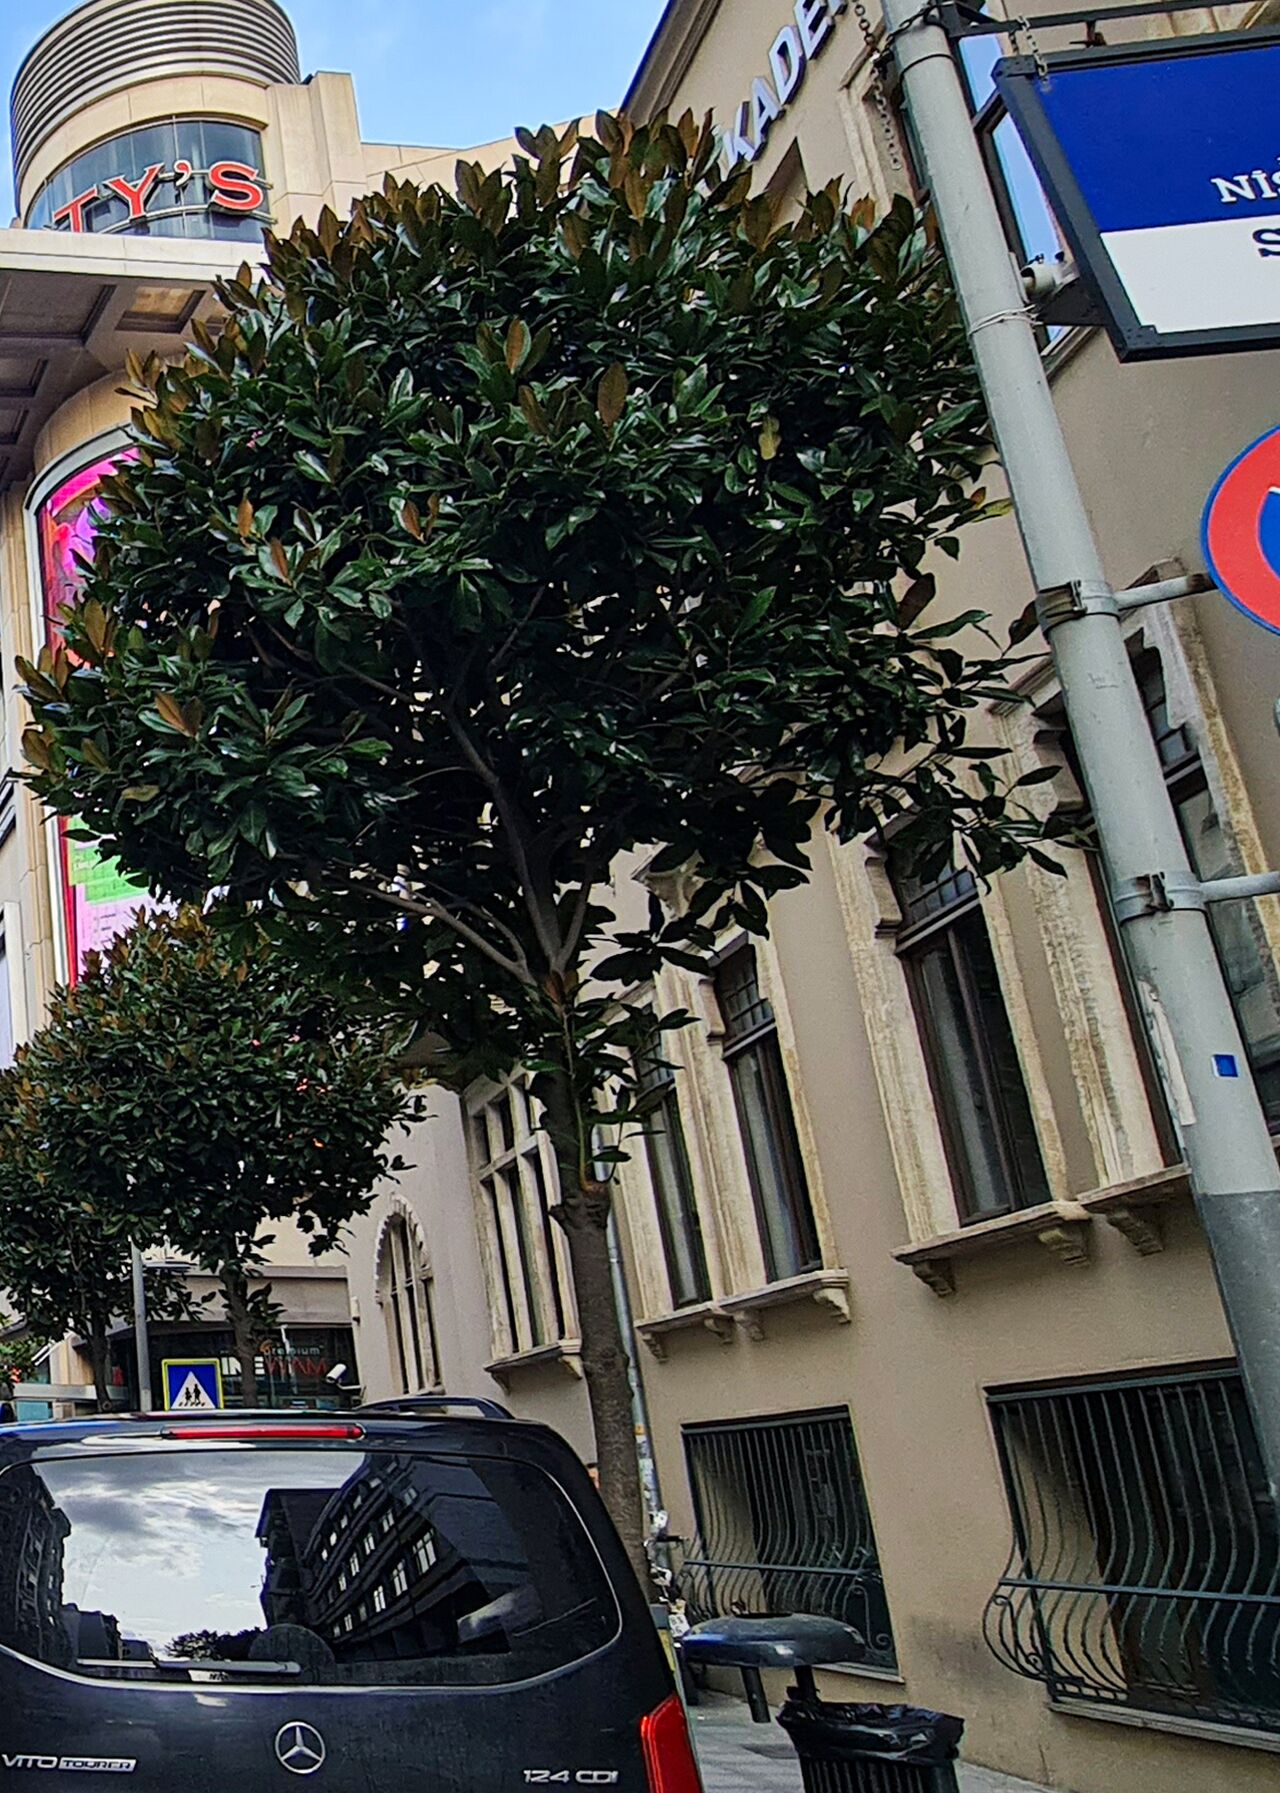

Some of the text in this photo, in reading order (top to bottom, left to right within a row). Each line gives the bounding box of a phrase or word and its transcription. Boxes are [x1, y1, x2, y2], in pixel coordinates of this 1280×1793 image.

[717, 0, 847, 182] KADE
[1, 1753, 133, 1771] VITO TOURER
[523, 1769, 619, 1783] 124 CDI
